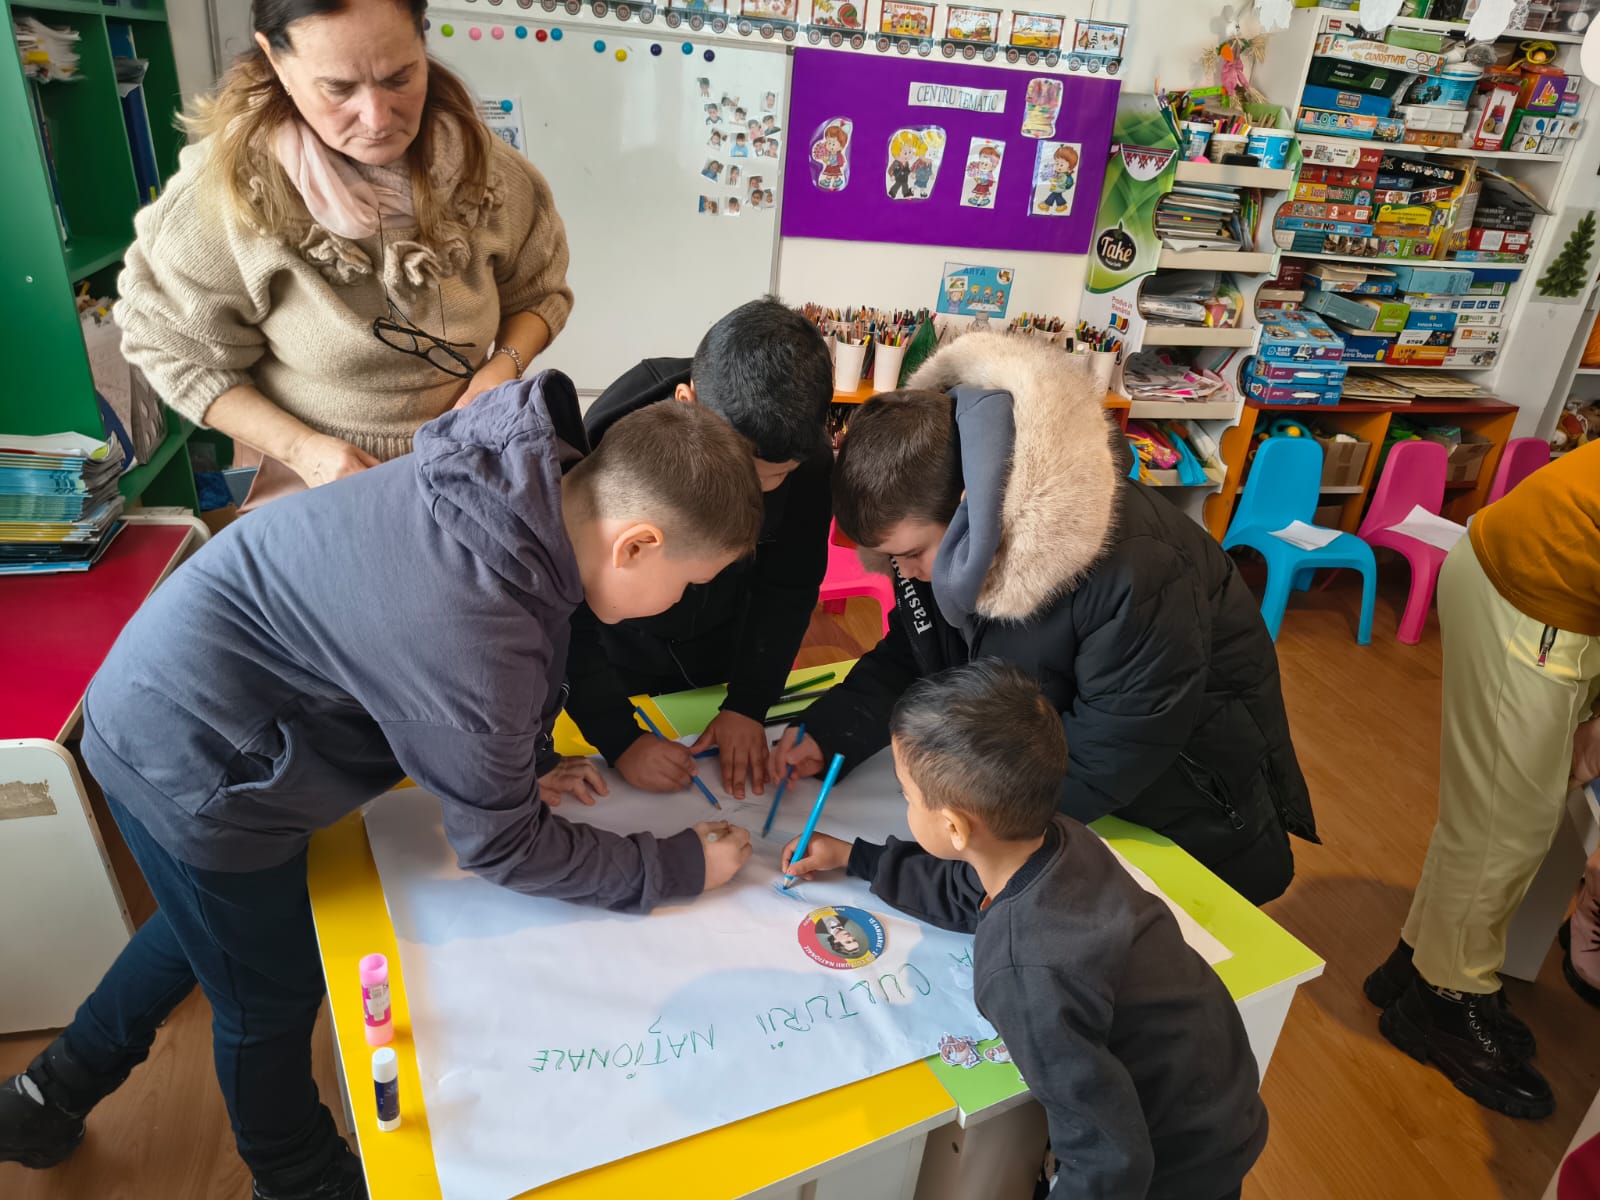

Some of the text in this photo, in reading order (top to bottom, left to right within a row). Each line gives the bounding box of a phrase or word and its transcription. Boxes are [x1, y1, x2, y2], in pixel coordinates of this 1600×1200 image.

[916, 85, 999, 112] CENTRU TEMATIC
[1305, 111, 1355, 129] BLOCKS
[1330, 205, 1339, 218] 3
[1101, 236, 1132, 263] Take
